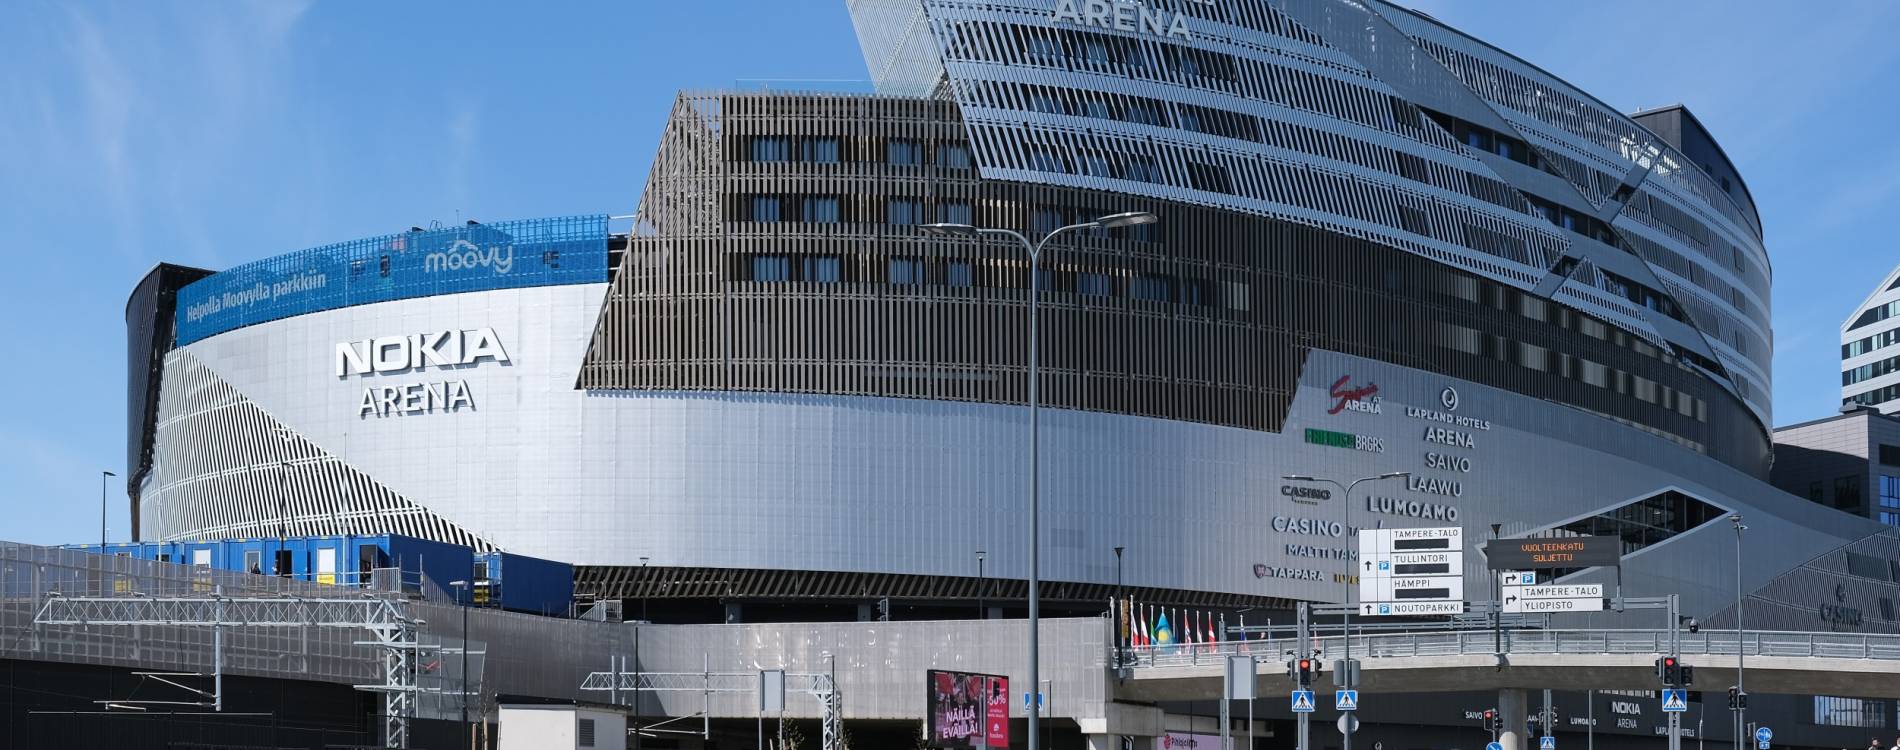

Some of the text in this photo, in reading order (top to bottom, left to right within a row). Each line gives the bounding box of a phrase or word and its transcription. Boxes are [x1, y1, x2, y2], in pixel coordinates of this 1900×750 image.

[1053, 0, 1191, 41] ARENA
[425, 240, 512, 273] moovy
[187, 270, 326, 323] Helpolla Moovylla parkkiin
[336, 328, 510, 378] NOKIA
[360, 380, 476, 418] ARENA
[1344, 399, 1382, 414] ARENA
[1407, 408, 1490, 430] LAPLAND HOTELS
[1426, 427, 1475, 448] ARENA
[1427, 452, 1471, 472] SAIVO
[1281, 486, 1331, 500] CASINO
[1408, 476, 1462, 496] LAAWU
[1368, 496, 1458, 521] LUMOAMO
[1272, 515, 1342, 538] CASINO
[1394, 530, 1458, 538] TAMPERE-TALO
[1286, 544, 1331, 559] MALTTI
[1521, 542, 1584, 551] VUOLTEENKATU
[1394, 555, 1448, 563] TULLINTORI
[1533, 553, 1573, 562] SULJETTU
[1272, 568, 1324, 581] TAPPARA
[1525, 587, 1598, 596] TAMPERE-TALO
[1394, 604, 1459, 612] NOUTOPARKKI
[1525, 601, 1573, 610] YLIOPISTO
[946, 705, 975, 723] NÄILLÄ
[1465, 711, 1483, 720] SAIVO
[1612, 701, 1640, 715] NOKIA
[943, 720, 978, 738] EVÄILLÄ!
[1570, 717, 1597, 726] LUMOAO
[1617, 718, 1638, 728] ARENA
